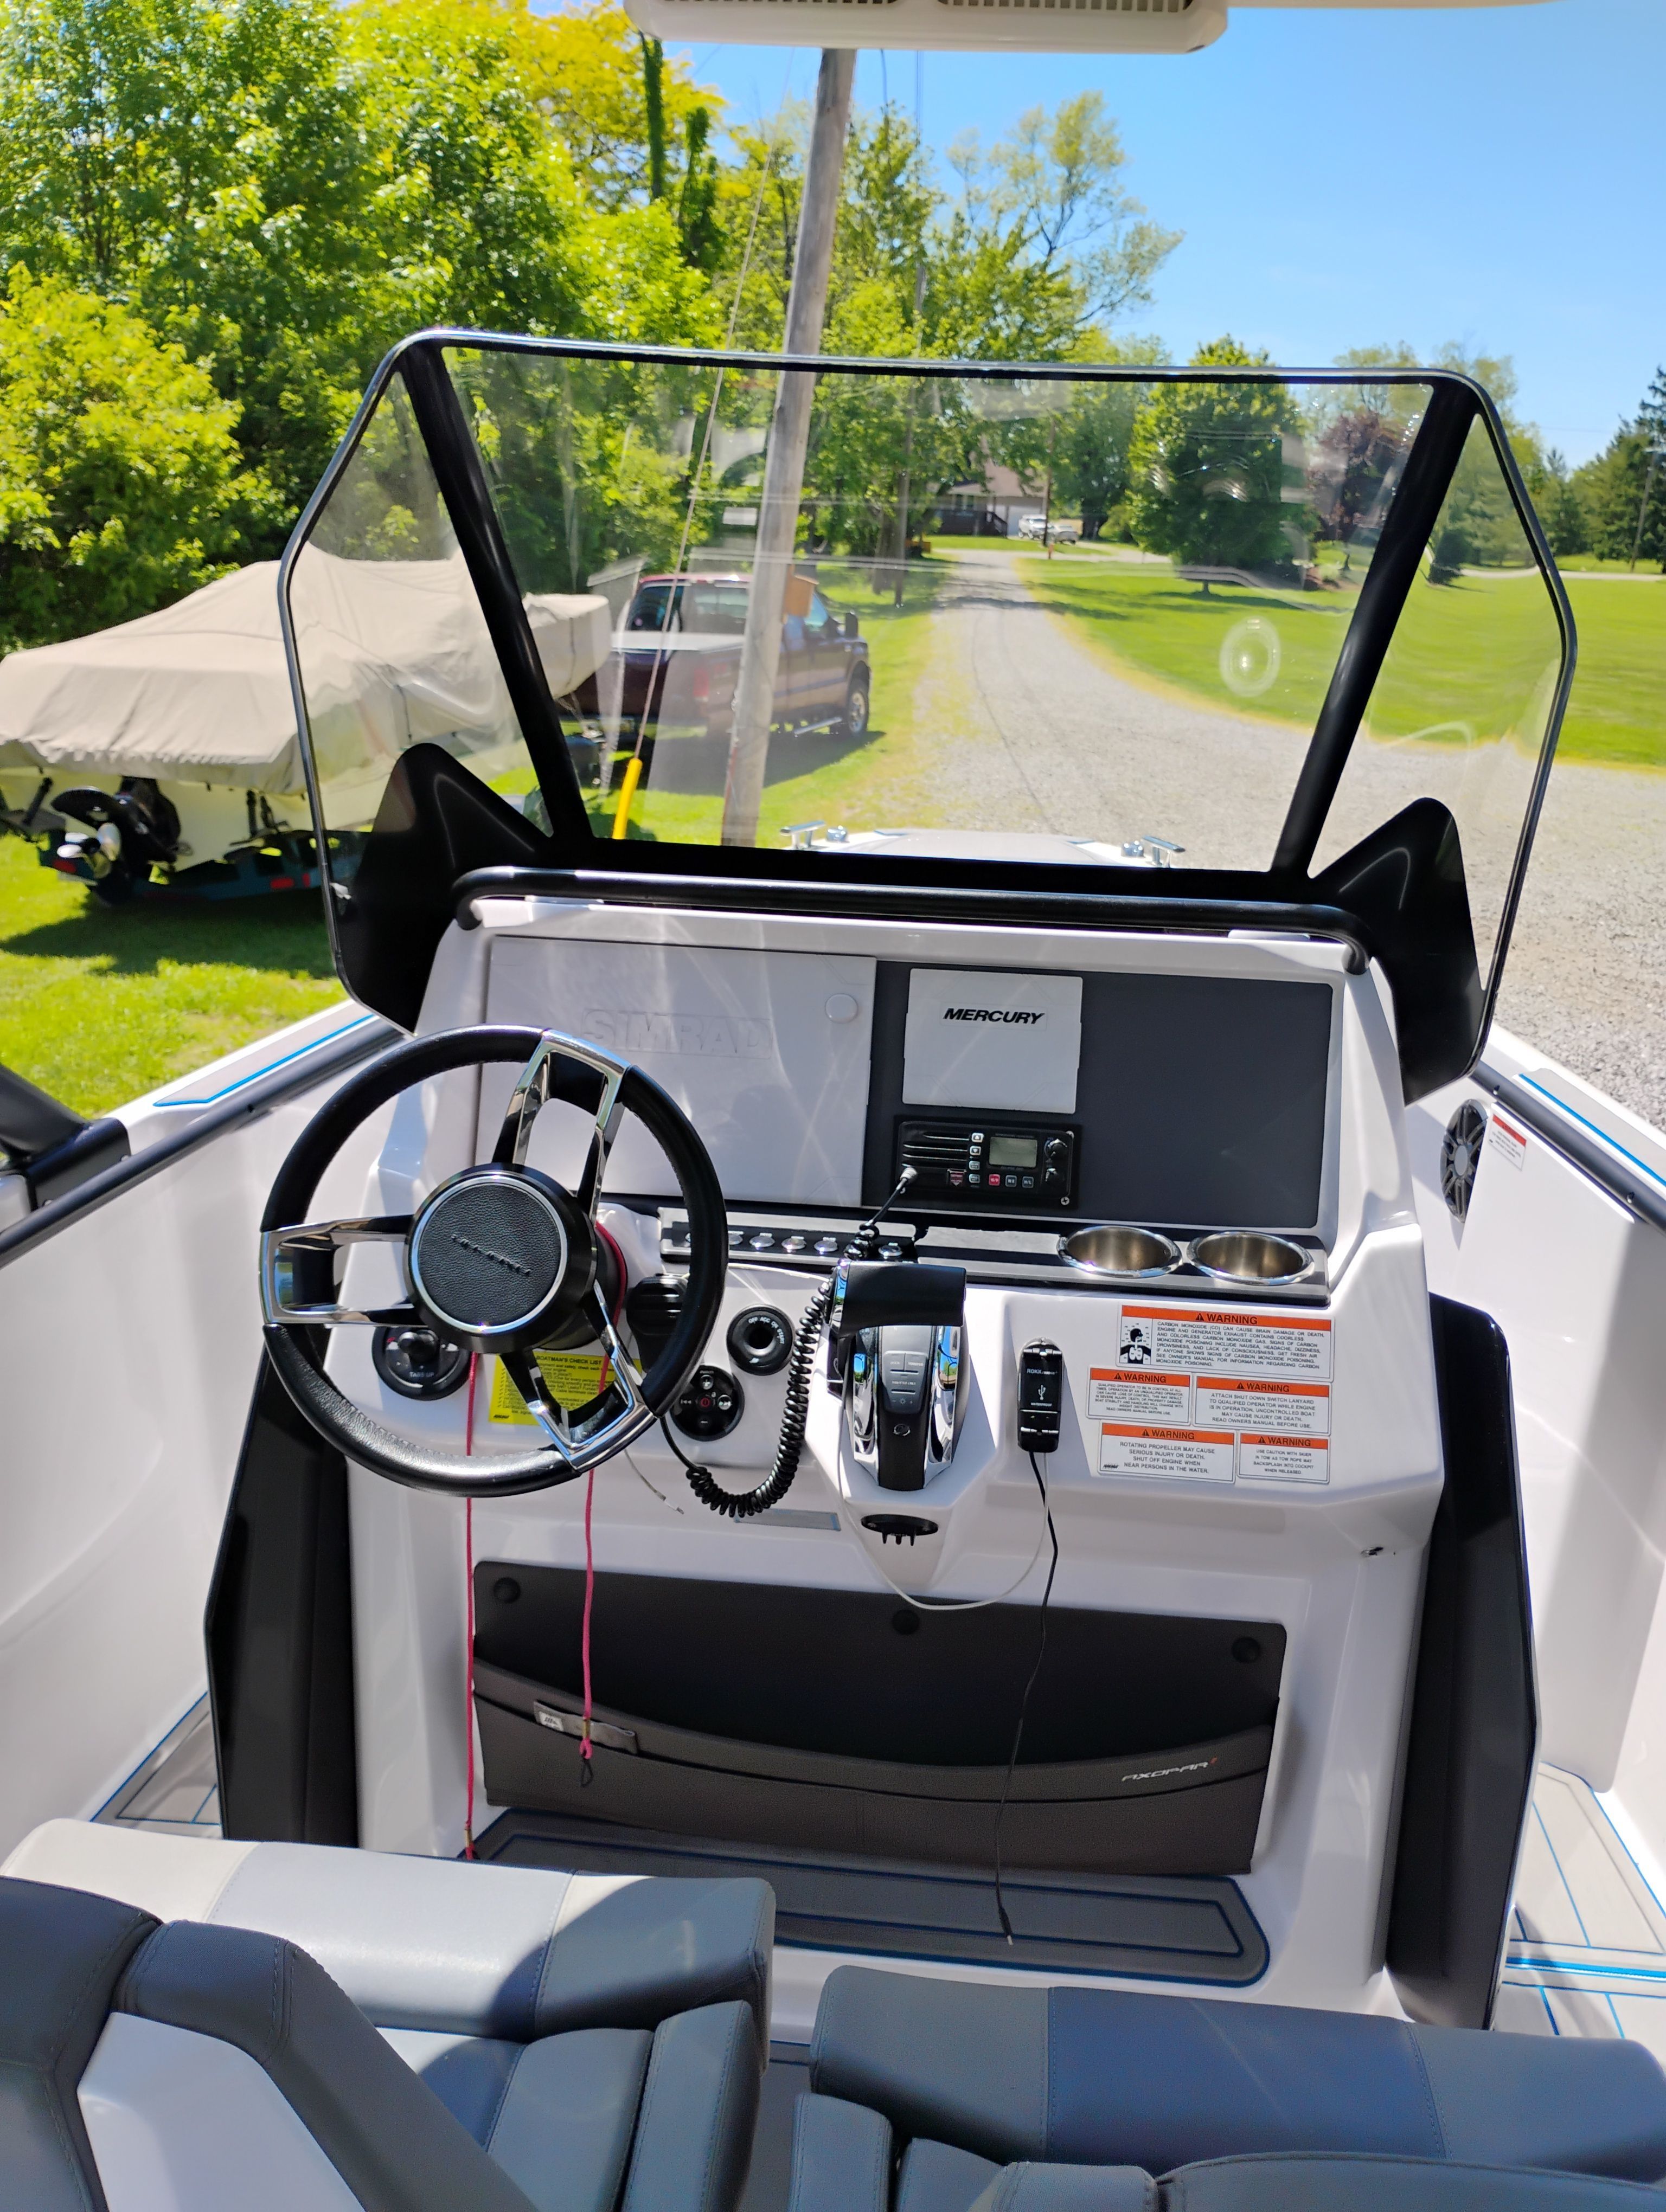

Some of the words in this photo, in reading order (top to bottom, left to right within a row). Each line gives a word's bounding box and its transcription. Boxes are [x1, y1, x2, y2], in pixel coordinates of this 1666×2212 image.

[943, 1008, 1045, 1025] MERCURY
[584, 1010, 771, 1056] SIMRAD
[1207, 1313, 1258, 1324] WARNING
[777, 1328, 785, 1345] START
[1124, 1373, 1166, 1383] WARNING
[1247, 1382, 1289, 1393] WARNING
[1151, 1429, 1194, 1440] WARNING
[1268, 1436, 1311, 1446] WARNING
[1122, 1761, 1208, 1782] AXOPAR
